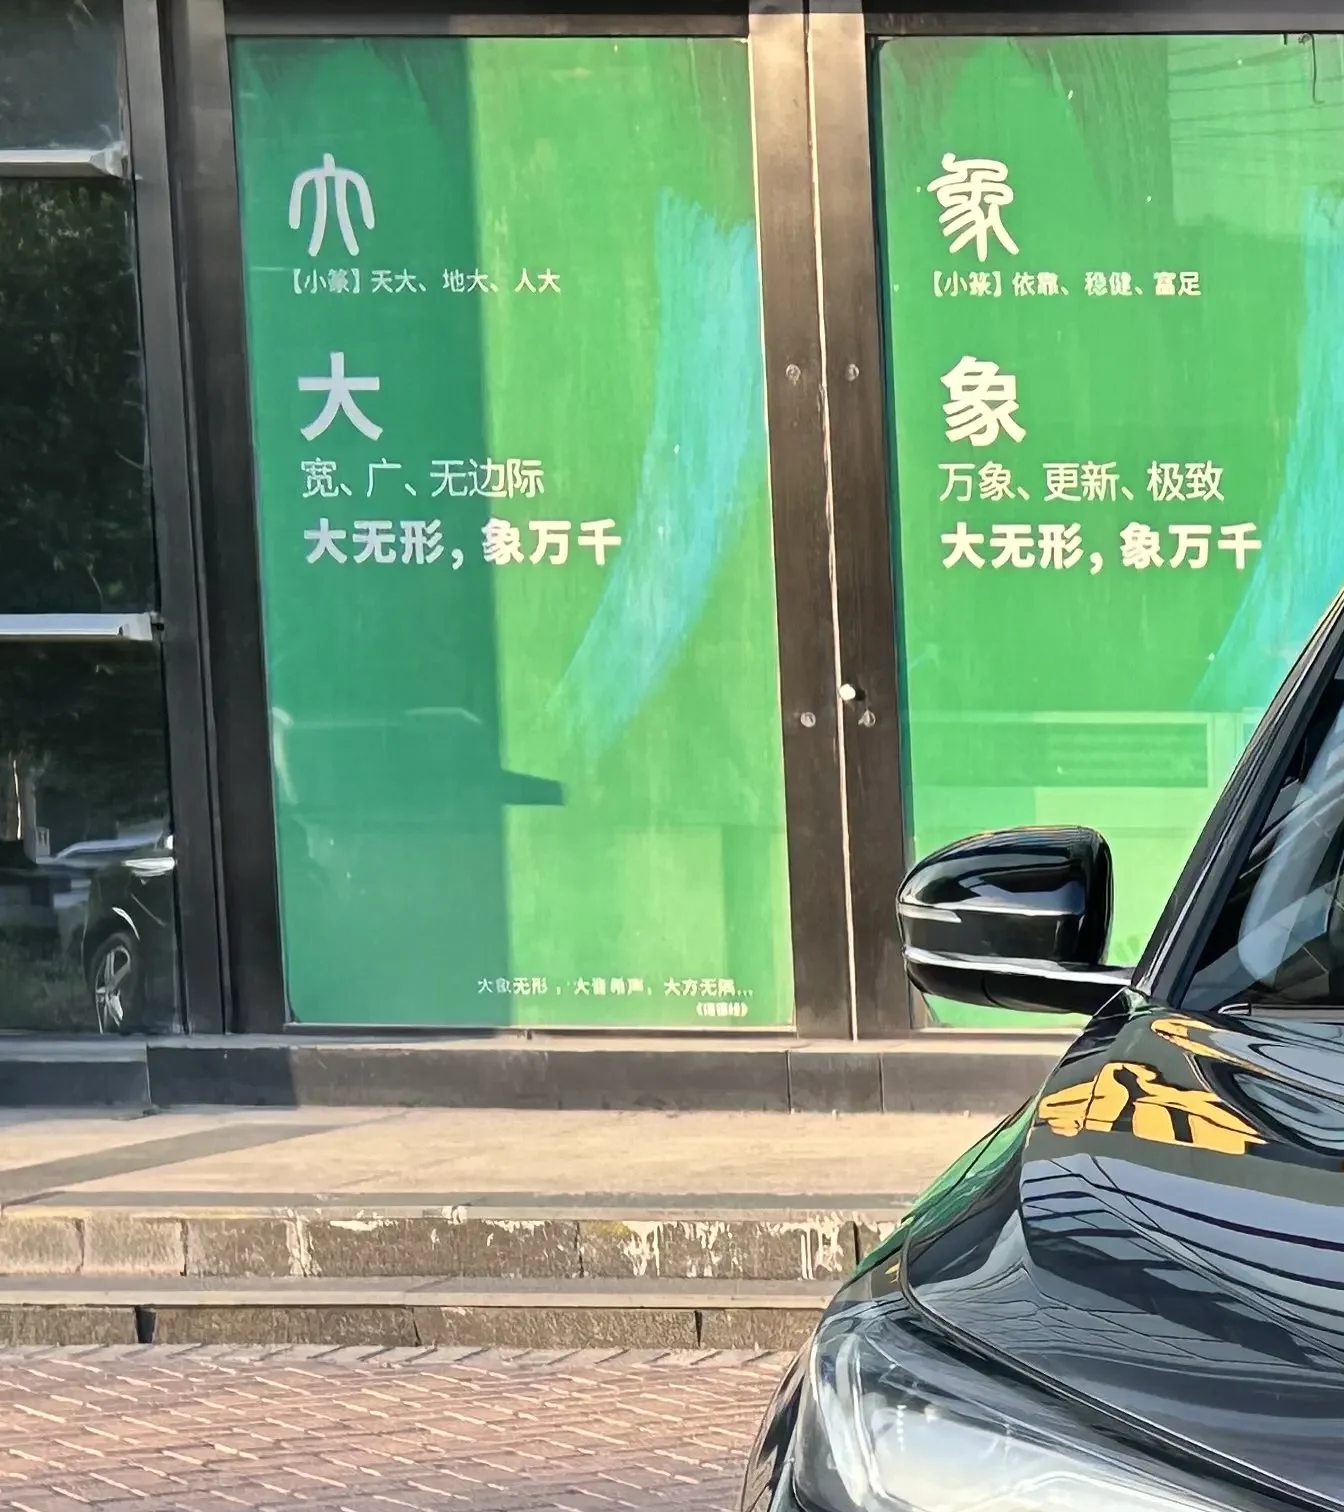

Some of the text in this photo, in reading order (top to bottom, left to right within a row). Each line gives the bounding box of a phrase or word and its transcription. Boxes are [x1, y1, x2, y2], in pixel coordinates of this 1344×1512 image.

[297, 351, 383, 442] 大
[940, 355, 1027, 447] 象
[301, 457, 545, 499] 宽、广、无边际
[938, 460, 1225, 503] 万象、更新、极致
[303, 517, 622, 570] 大无形，象万千
[940, 520, 1262, 575] 大无形，象万千
